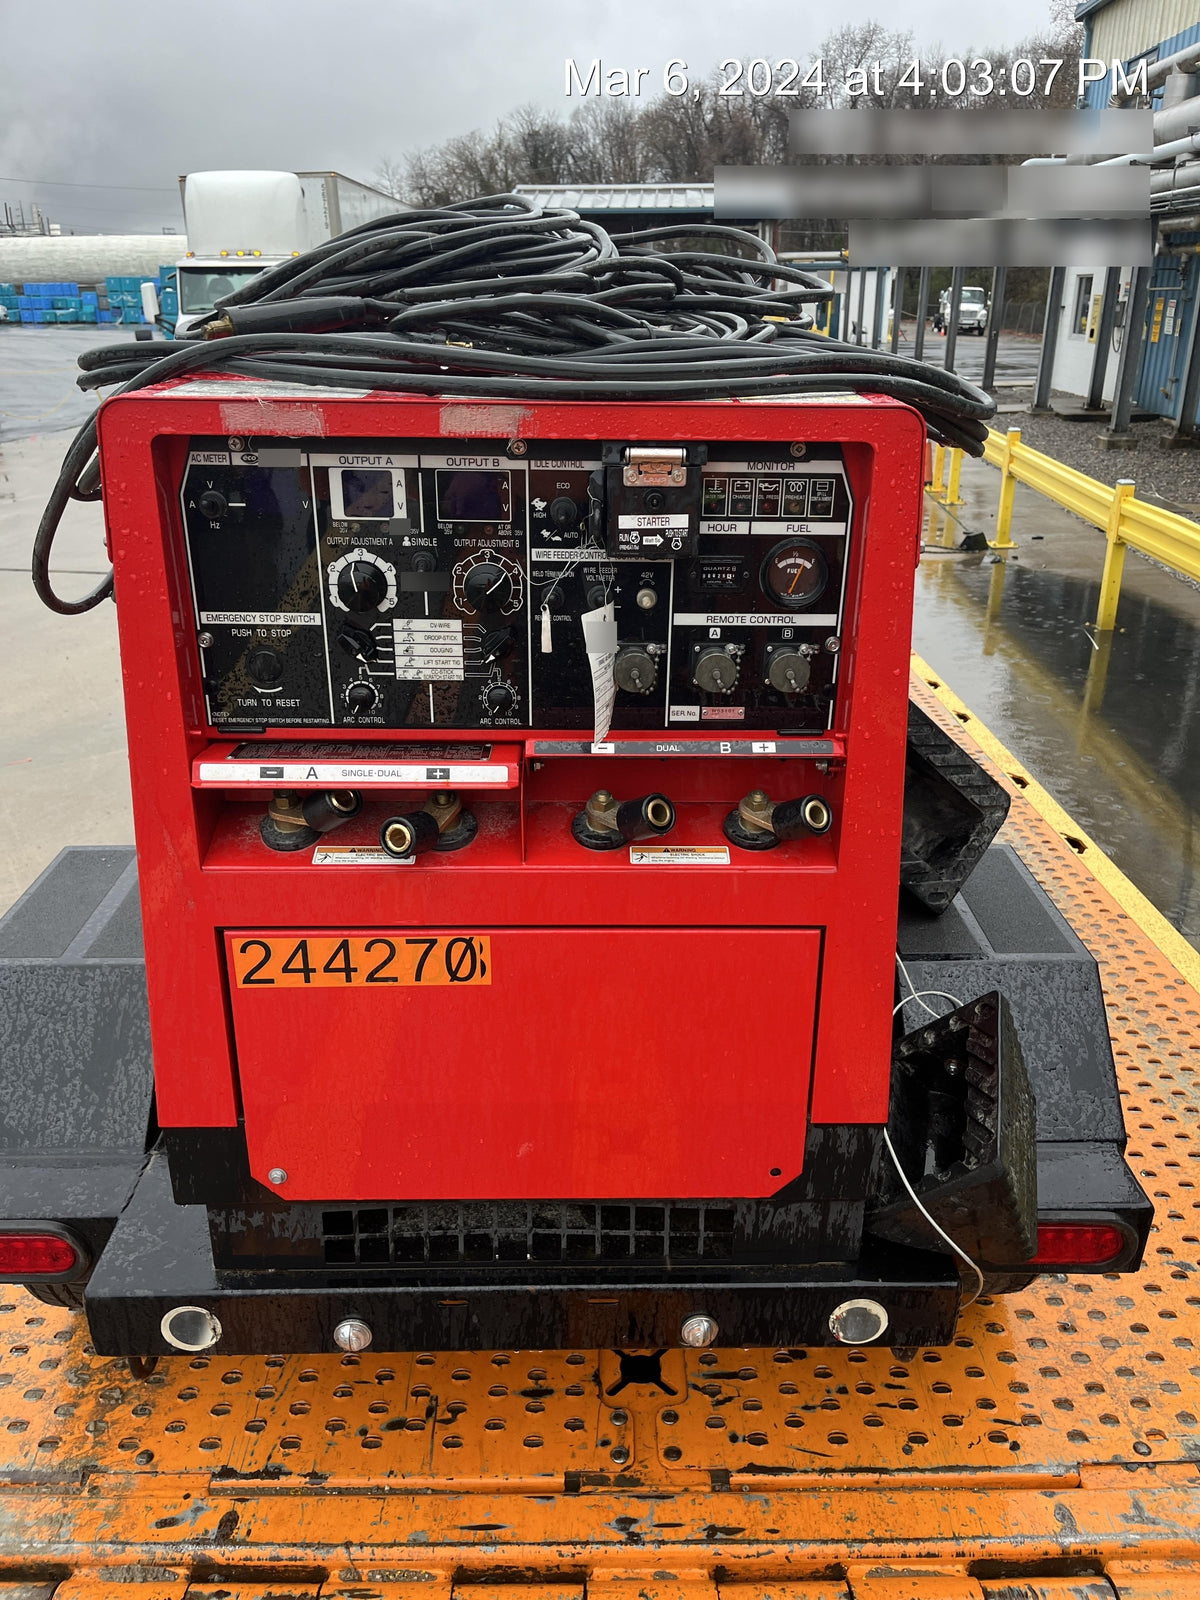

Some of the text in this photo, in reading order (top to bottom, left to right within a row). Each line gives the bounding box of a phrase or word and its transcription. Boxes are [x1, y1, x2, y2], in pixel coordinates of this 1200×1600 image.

[191, 454, 228, 464] AC METER
[338, 456, 394, 466] OUTPUT A
[446, 458, 500, 467] OUTPUT B
[534, 460, 584, 468] IDLE CONTROL
[747, 462, 796, 471] MONITOR
[206, 480, 214, 489] V
[396, 480, 403, 488] A
[502, 481, 509, 489] A
[189, 500, 196, 509] A
[302, 500, 309, 509] V
[397, 502, 404, 510] V
[502, 504, 509, 512] V
[210, 520, 220, 529] Hz
[637, 516, 670, 526] STARTER
[707, 523, 737, 532] HOUR
[786, 524, 812, 533] FUEL
[327, 537, 349, 545] OUTPUT
[350, 537, 388, 545] ADJUSTMENT
[410, 538, 438, 546] SINGLE
[454, 539, 477, 547] OUTPUT
[478, 539, 514, 548] ADJUSTMENT
[535, 551, 552, 559] WIRE
[553, 551, 578, 560] FEEDER
[206, 614, 316, 623] EMERGENCY STOP SWITCH
[706, 616, 797, 624] REMOTE CONTROL
[231, 629, 292, 637] PUSH TO STOP
[237, 699, 301, 707] TURN TO RESET
[656, 744, 680, 752] DUAL
[720, 742, 732, 754] B
[306, 767, 318, 779] A
